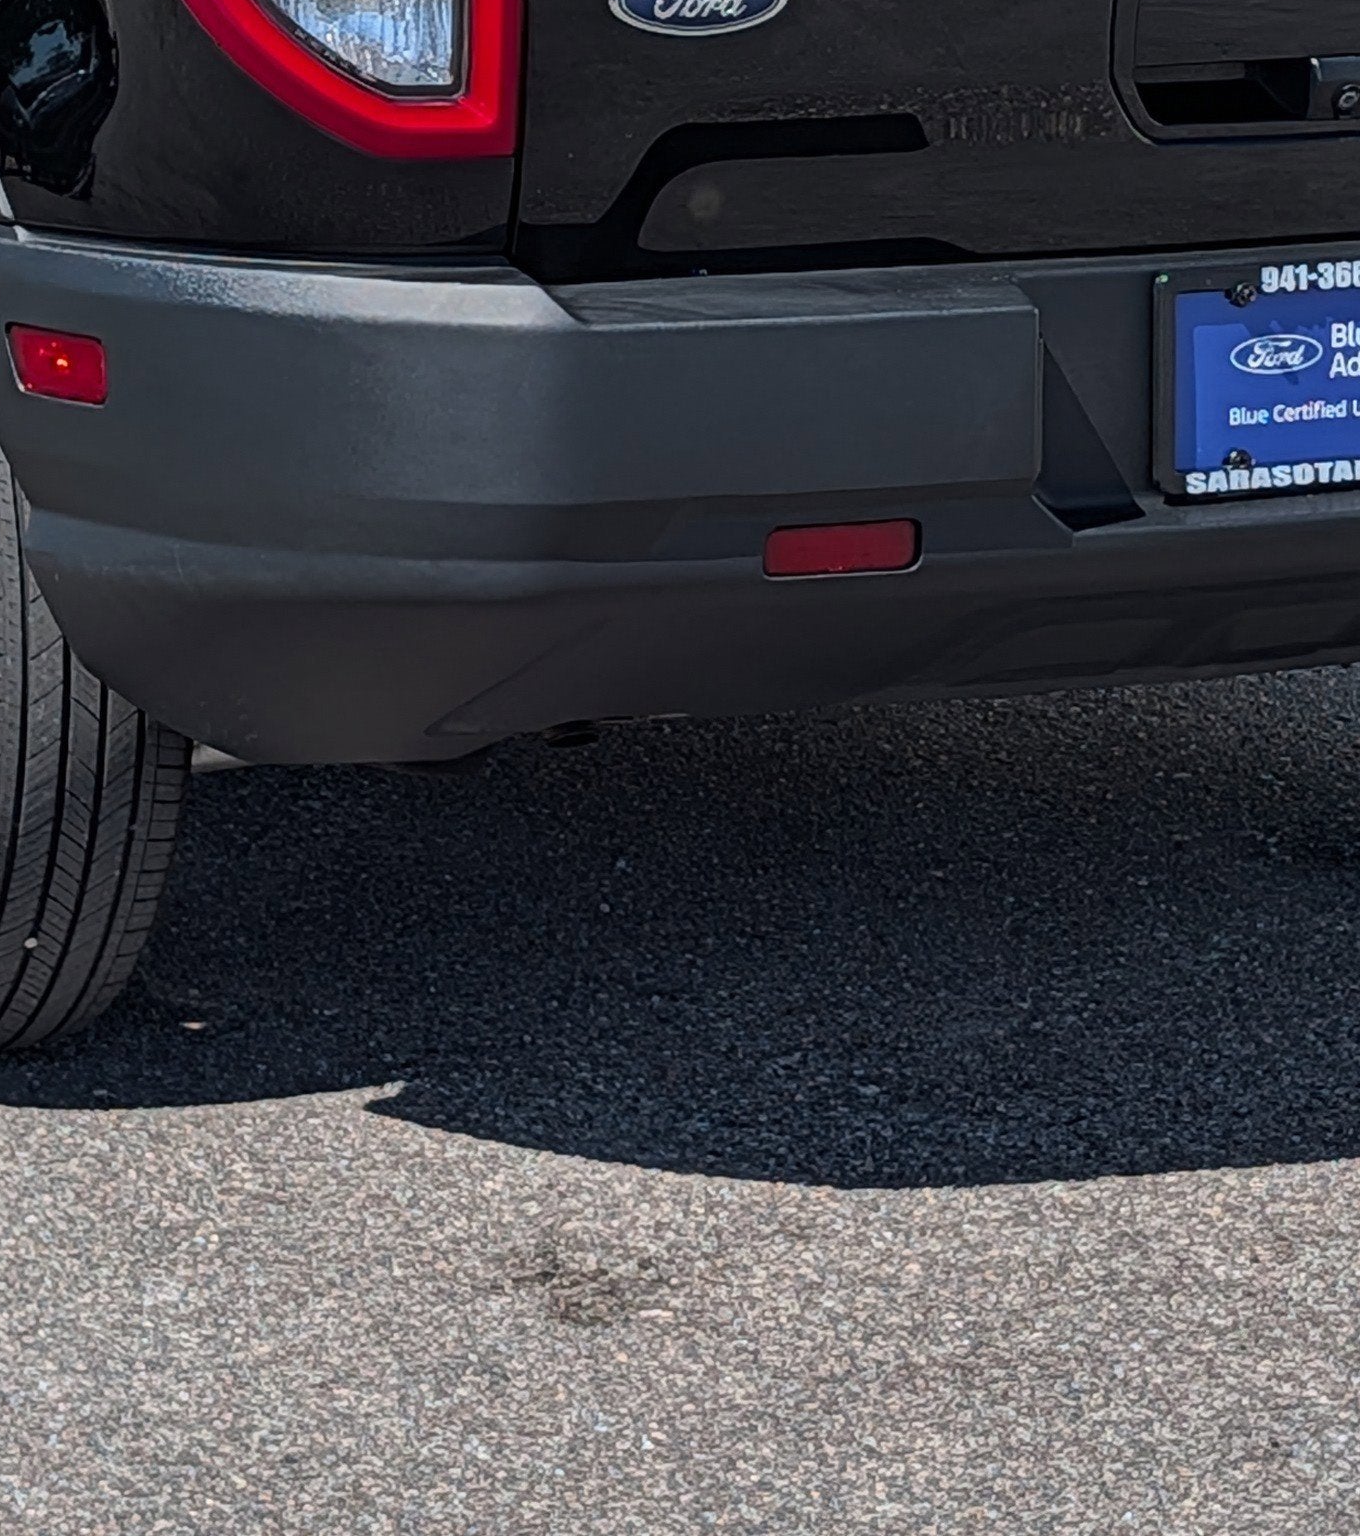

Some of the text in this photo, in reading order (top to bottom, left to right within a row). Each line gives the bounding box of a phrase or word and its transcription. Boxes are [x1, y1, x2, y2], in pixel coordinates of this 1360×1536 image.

[1247, 340, 1305, 368] Ford
[1229, 407, 1269, 426] Blue
[1273, 399, 1347, 423] Certified
